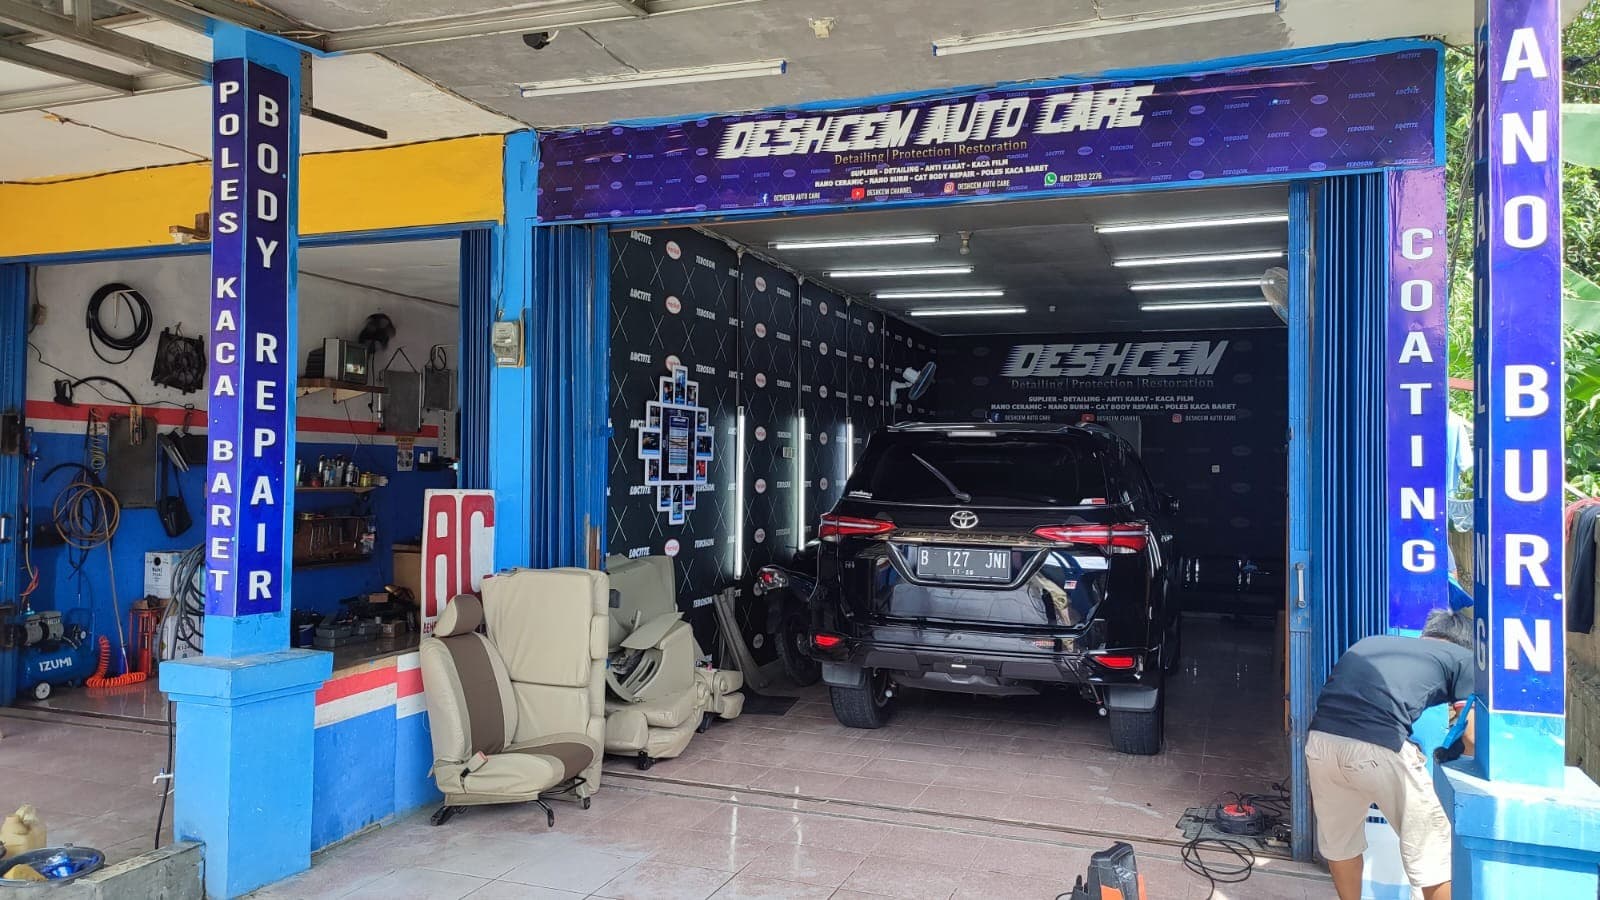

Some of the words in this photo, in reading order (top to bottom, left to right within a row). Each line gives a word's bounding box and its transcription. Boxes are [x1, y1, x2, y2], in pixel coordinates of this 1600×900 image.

[714, 109, 919, 159] DESHCEM
[913, 97, 1030, 145] AUTO
[1032, 85, 1155, 134] CARE
[218, 80, 240, 234] POLES
[835, 152, 884, 165] Detailing
[892, 147, 950, 160] Protection
[959, 140, 1027, 155] Restoration
[884, 166, 919, 174] DETAILING
[992, 159, 1008, 167] FILM
[256, 94, 280, 270] BODY
[929, 172, 948, 180] BODY
[981, 168, 1003, 177] POLES
[1005, 166, 1023, 174] KACA
[630, 231, 652, 245] LOCTITE
[630, 288, 651, 302] LOCTITE
[214, 276, 238, 397] KACA
[630, 352, 651, 364] LOCTITE
[1000, 340, 1229, 377] DESHCEM
[1011, 379, 1063, 390] Detailing
[1072, 378, 1133, 389] Protection
[1142, 377, 1214, 388] Restoration
[1398, 227, 1436, 573] COATING
[248, 332, 279, 601] REPAIR
[210, 439, 234, 592] BARET
[1503, 364, 1552, 673] BURN
[425, 494, 494, 618] AC
[629, 546, 650, 559] LOCTITE
[921, 549, 929, 565] B
[947, 551, 970, 567] 127
[985, 552, 1007, 569] JNI
[38, 656, 72, 672] IZUMI
